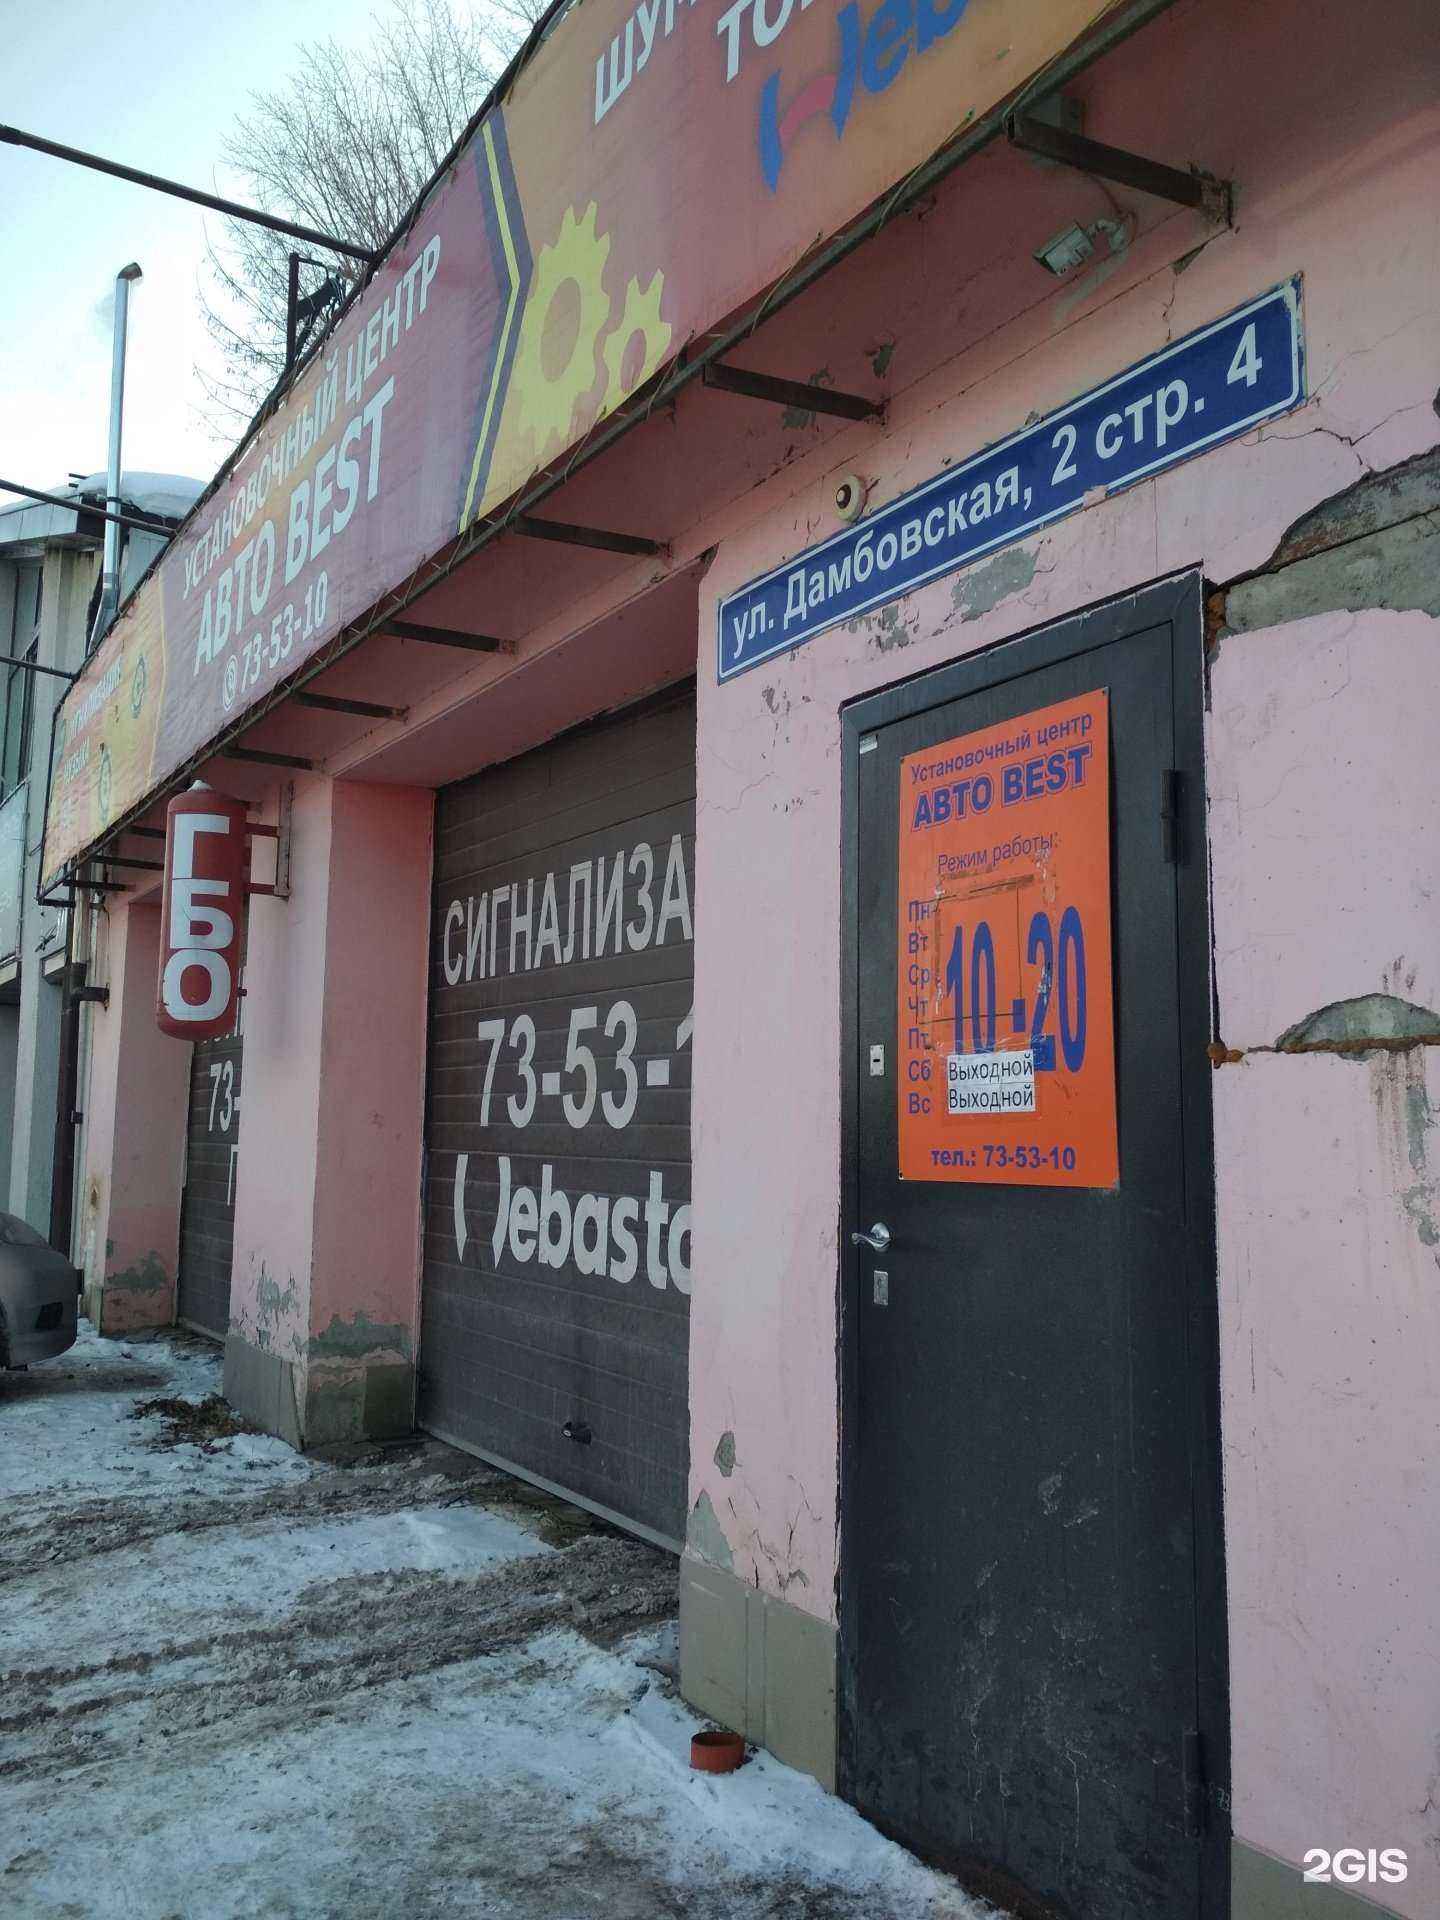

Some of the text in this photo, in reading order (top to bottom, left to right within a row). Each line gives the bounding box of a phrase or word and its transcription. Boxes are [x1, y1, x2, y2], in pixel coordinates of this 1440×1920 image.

[717, 0, 813, 83] ТО
[183, 234, 441, 600] УСТАНОВОЧНЫЙ ЦЕНТР
[732, 322, 1264, 659] ул. Дамбовская, 2 стр. 4
[194, 375, 395, 678] АВТО BEST
[241, 570, 328, 694] 73-53-10
[911, 713, 1093, 785] Установочный центр
[911, 741, 1093, 832] АВТО BEST
[937, 832, 1061, 874] Режим работы:
[162, 812, 234, 1022] ГБО
[908, 901, 931, 923] Пн
[908, 932, 929, 954] Вт
[908, 963, 931, 989] Ср
[908, 997, 929, 1017] Чт
[908, 1028, 930, 1049] Пт
[908, 1059, 932, 1082] Сб
[949, 1053, 1033, 1083] Выходной
[908, 1092, 932, 1114] Вс
[949, 1084, 1033, 1111] Выходной
[931, 1144, 1076, 1170] тел.: 73-53-10
